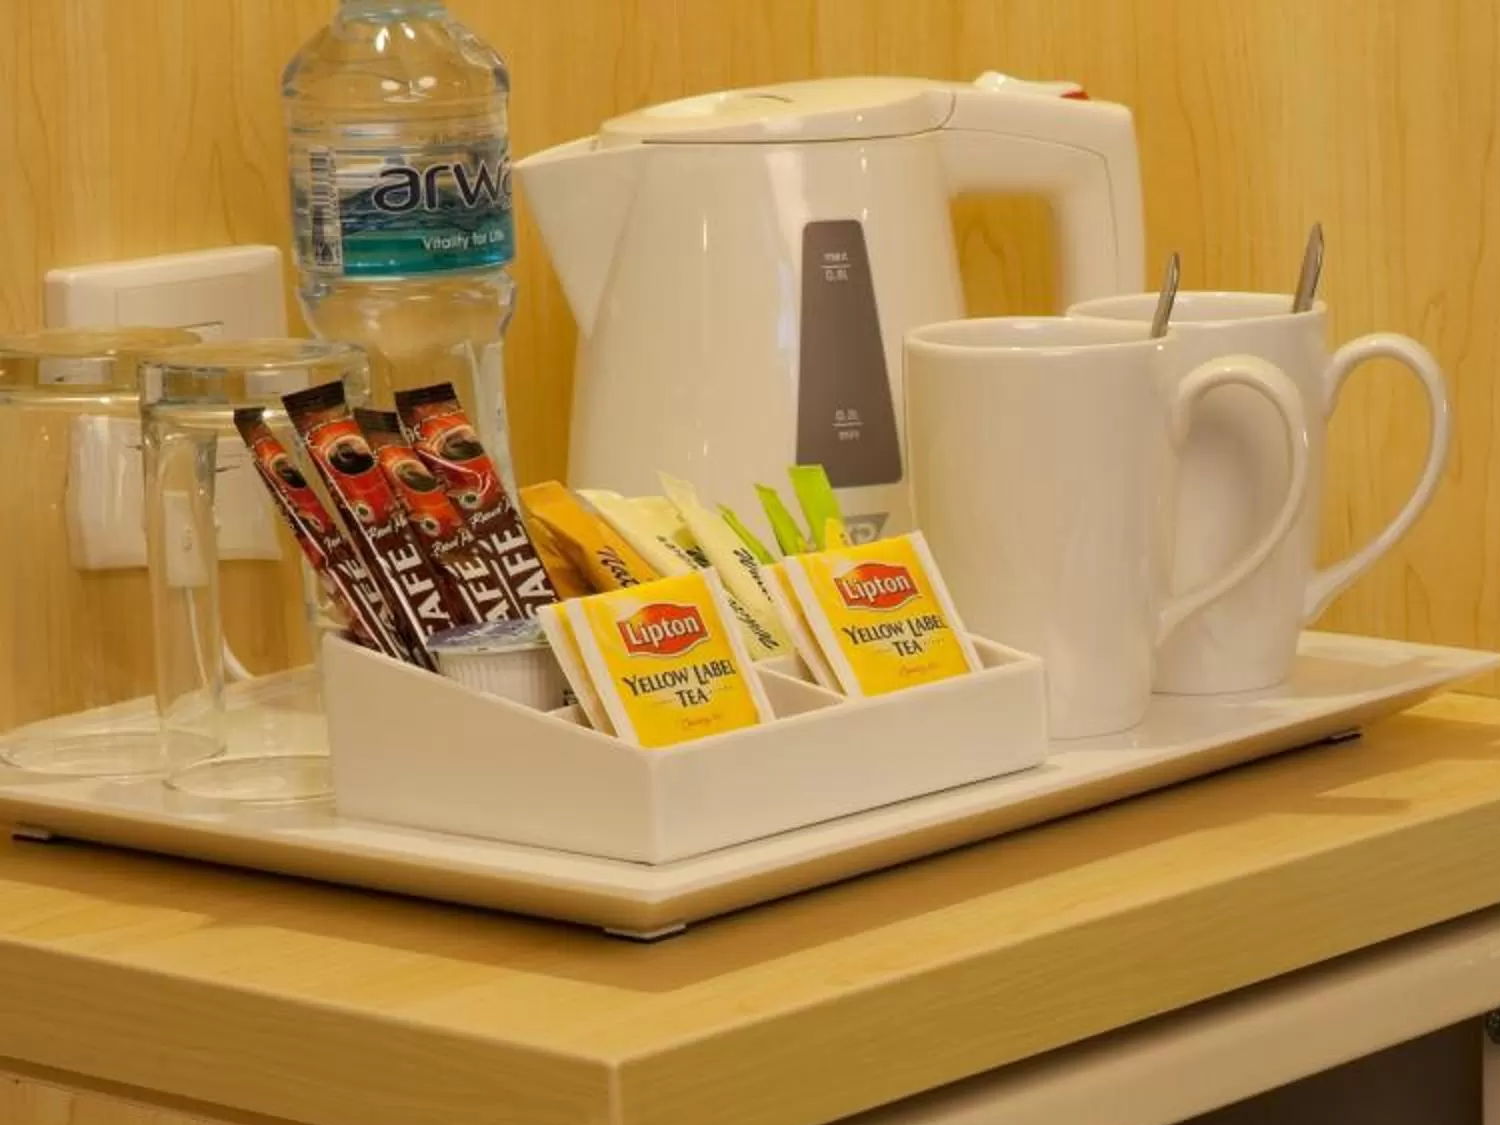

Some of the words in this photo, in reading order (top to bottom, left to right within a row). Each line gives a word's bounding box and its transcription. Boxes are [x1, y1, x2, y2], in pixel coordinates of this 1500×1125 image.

[422, 234, 469, 251] Vitality
[841, 574, 911, 603] Lipton
[625, 615, 700, 649] Lipton
[841, 621, 906, 645] YELLOW
[906, 613, 949, 637] LABEL
[891, 639, 923, 657] TEA
[621, 666, 690, 697] YELLOW
[692, 658, 737, 686] LABEL
[675, 687, 709, 708] TEA
